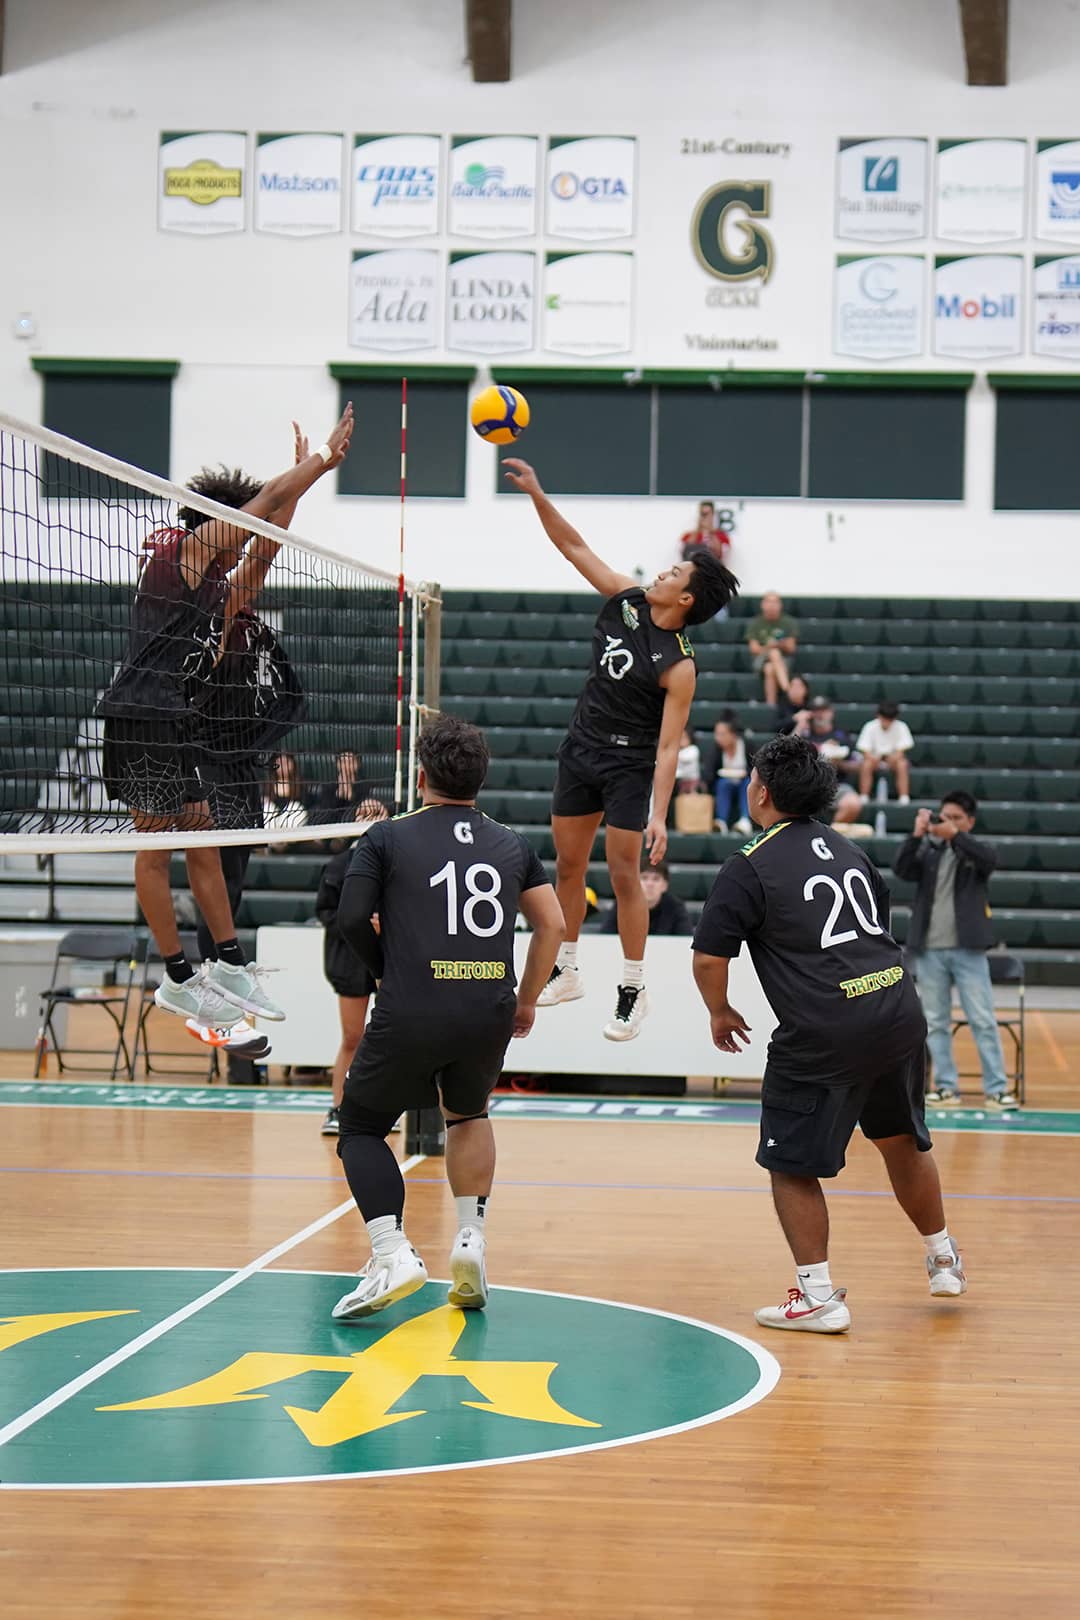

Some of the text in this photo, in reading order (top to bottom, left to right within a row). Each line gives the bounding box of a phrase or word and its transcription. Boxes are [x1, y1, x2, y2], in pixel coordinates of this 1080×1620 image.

[260, 173, 338, 192] Matson
[357, 165, 436, 182] CARS
[582, 177, 627, 196] GTA
[451, 279, 533, 298] LINDA
[356, 289, 428, 322] Ada
[453, 302, 528, 322] LOOK
[936, 295, 1015, 318] Mobil
[453, 821, 474, 845] G
[811, 837, 834, 861] G
[429, 861, 504, 938] 18
[803, 868, 884, 950] 20
[431, 960, 506, 979] TRITONS
